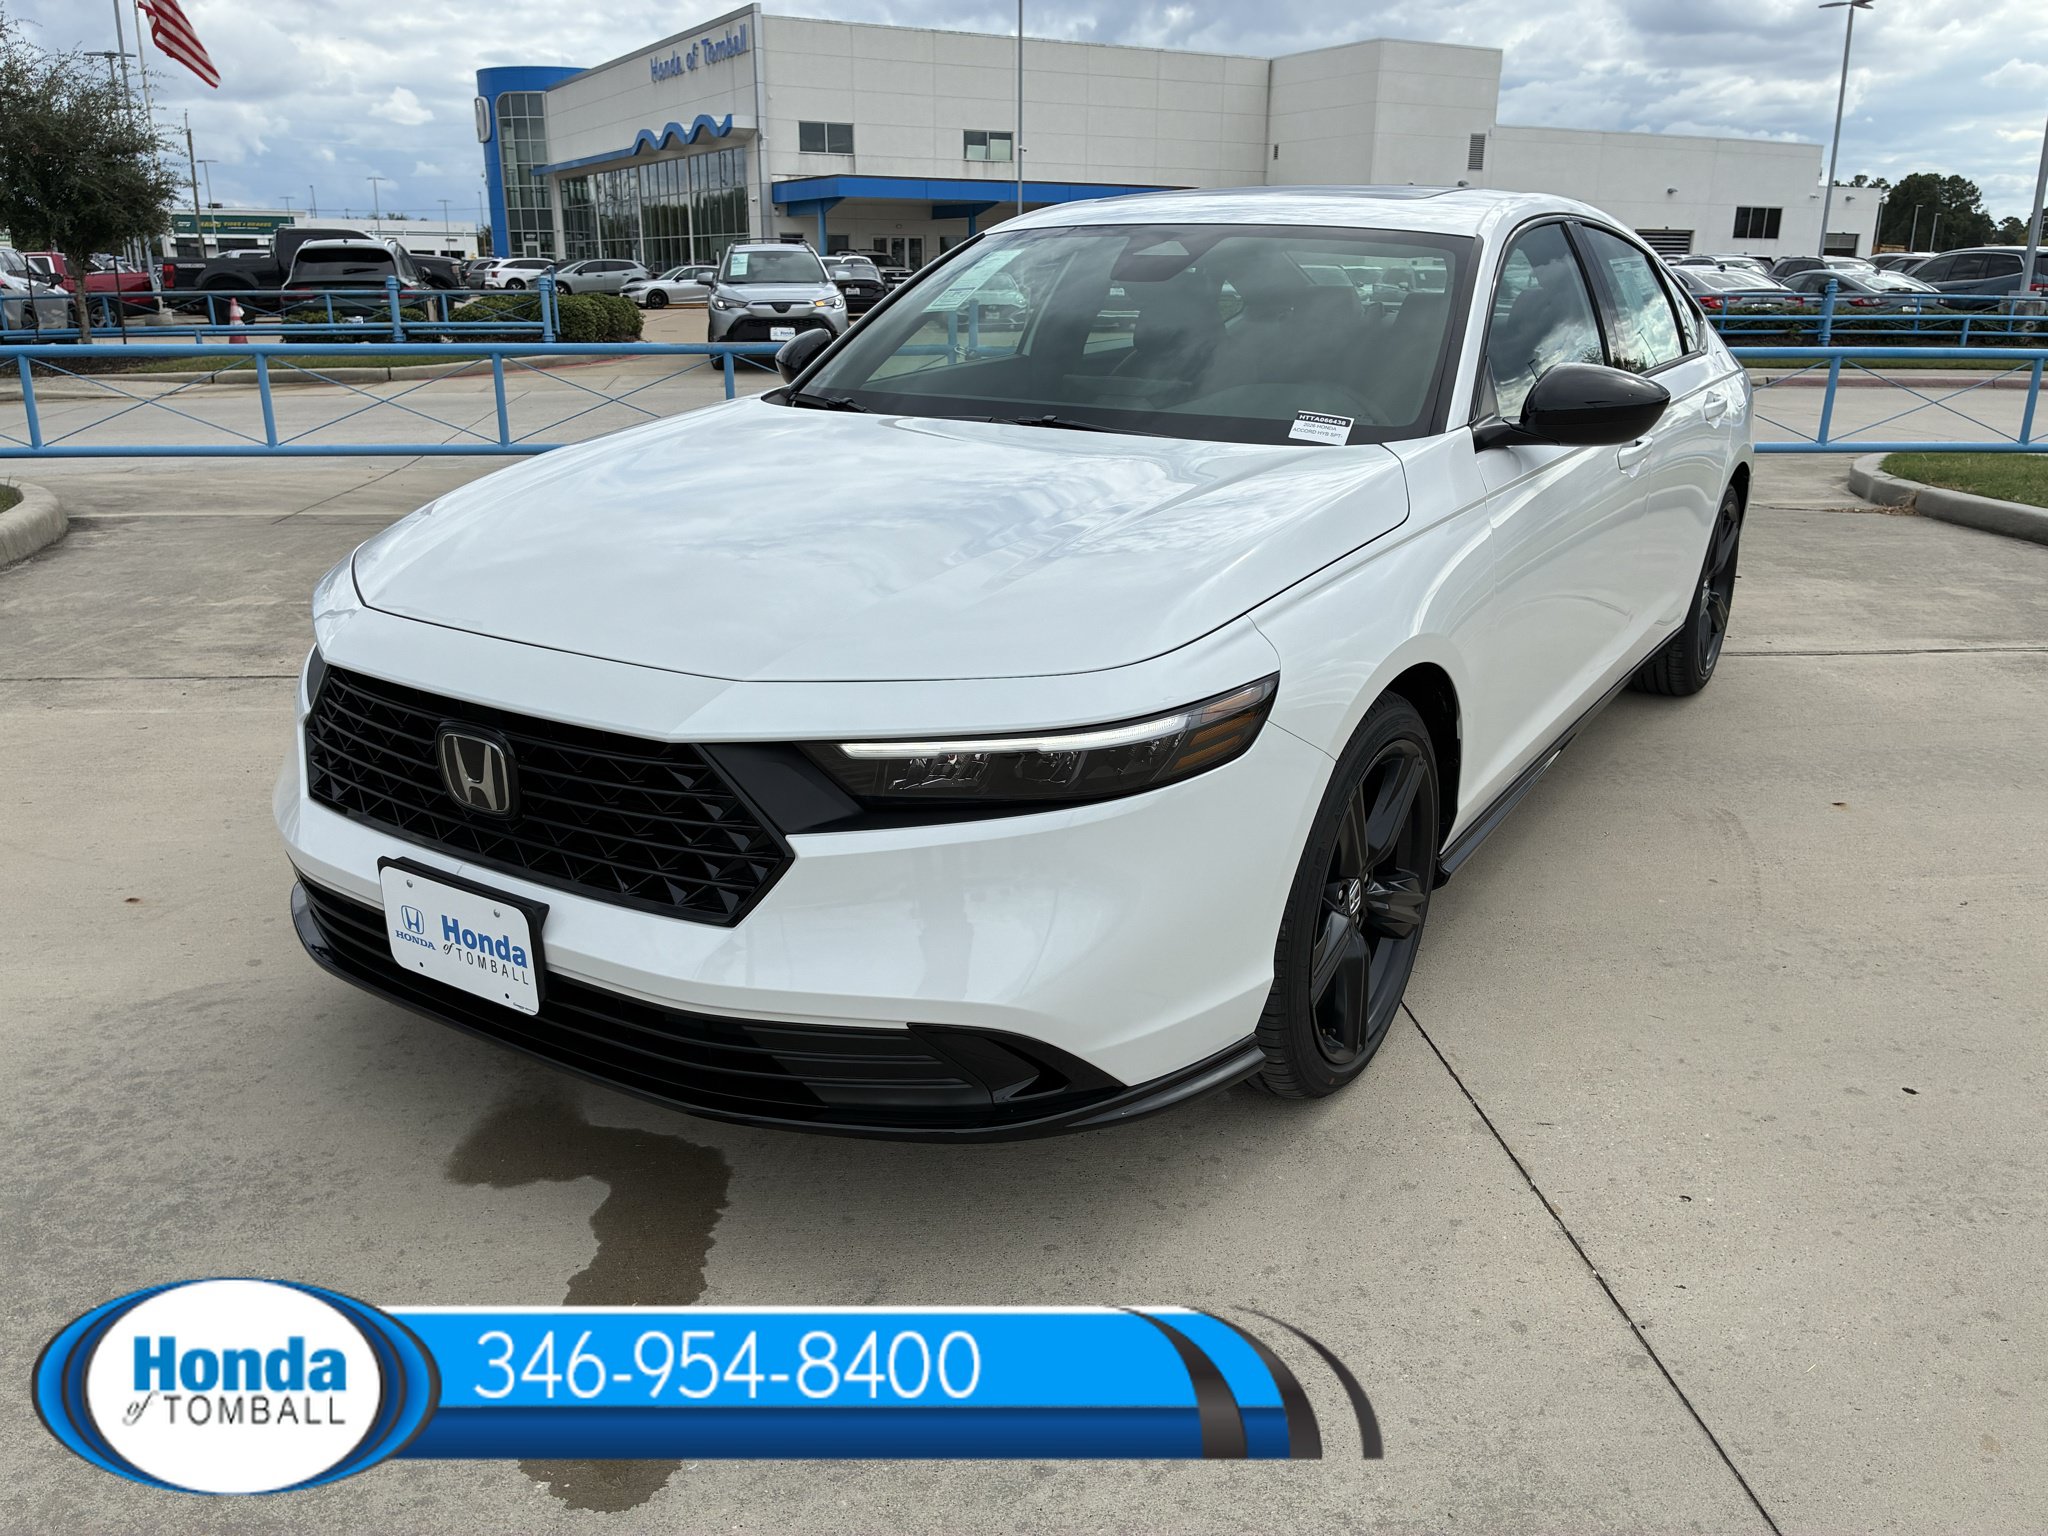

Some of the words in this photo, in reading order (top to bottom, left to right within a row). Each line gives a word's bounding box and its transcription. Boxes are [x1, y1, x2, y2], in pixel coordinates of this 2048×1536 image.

[650, 50, 684, 82] Honda
[686, 43, 699, 71] of
[701, 24, 748, 65] Tomball
[395, 929, 436, 951] HONDA
[441, 914, 528, 969] Honda
[442, 942, 454, 955] of
[455, 947, 529, 985] TOMBALL
